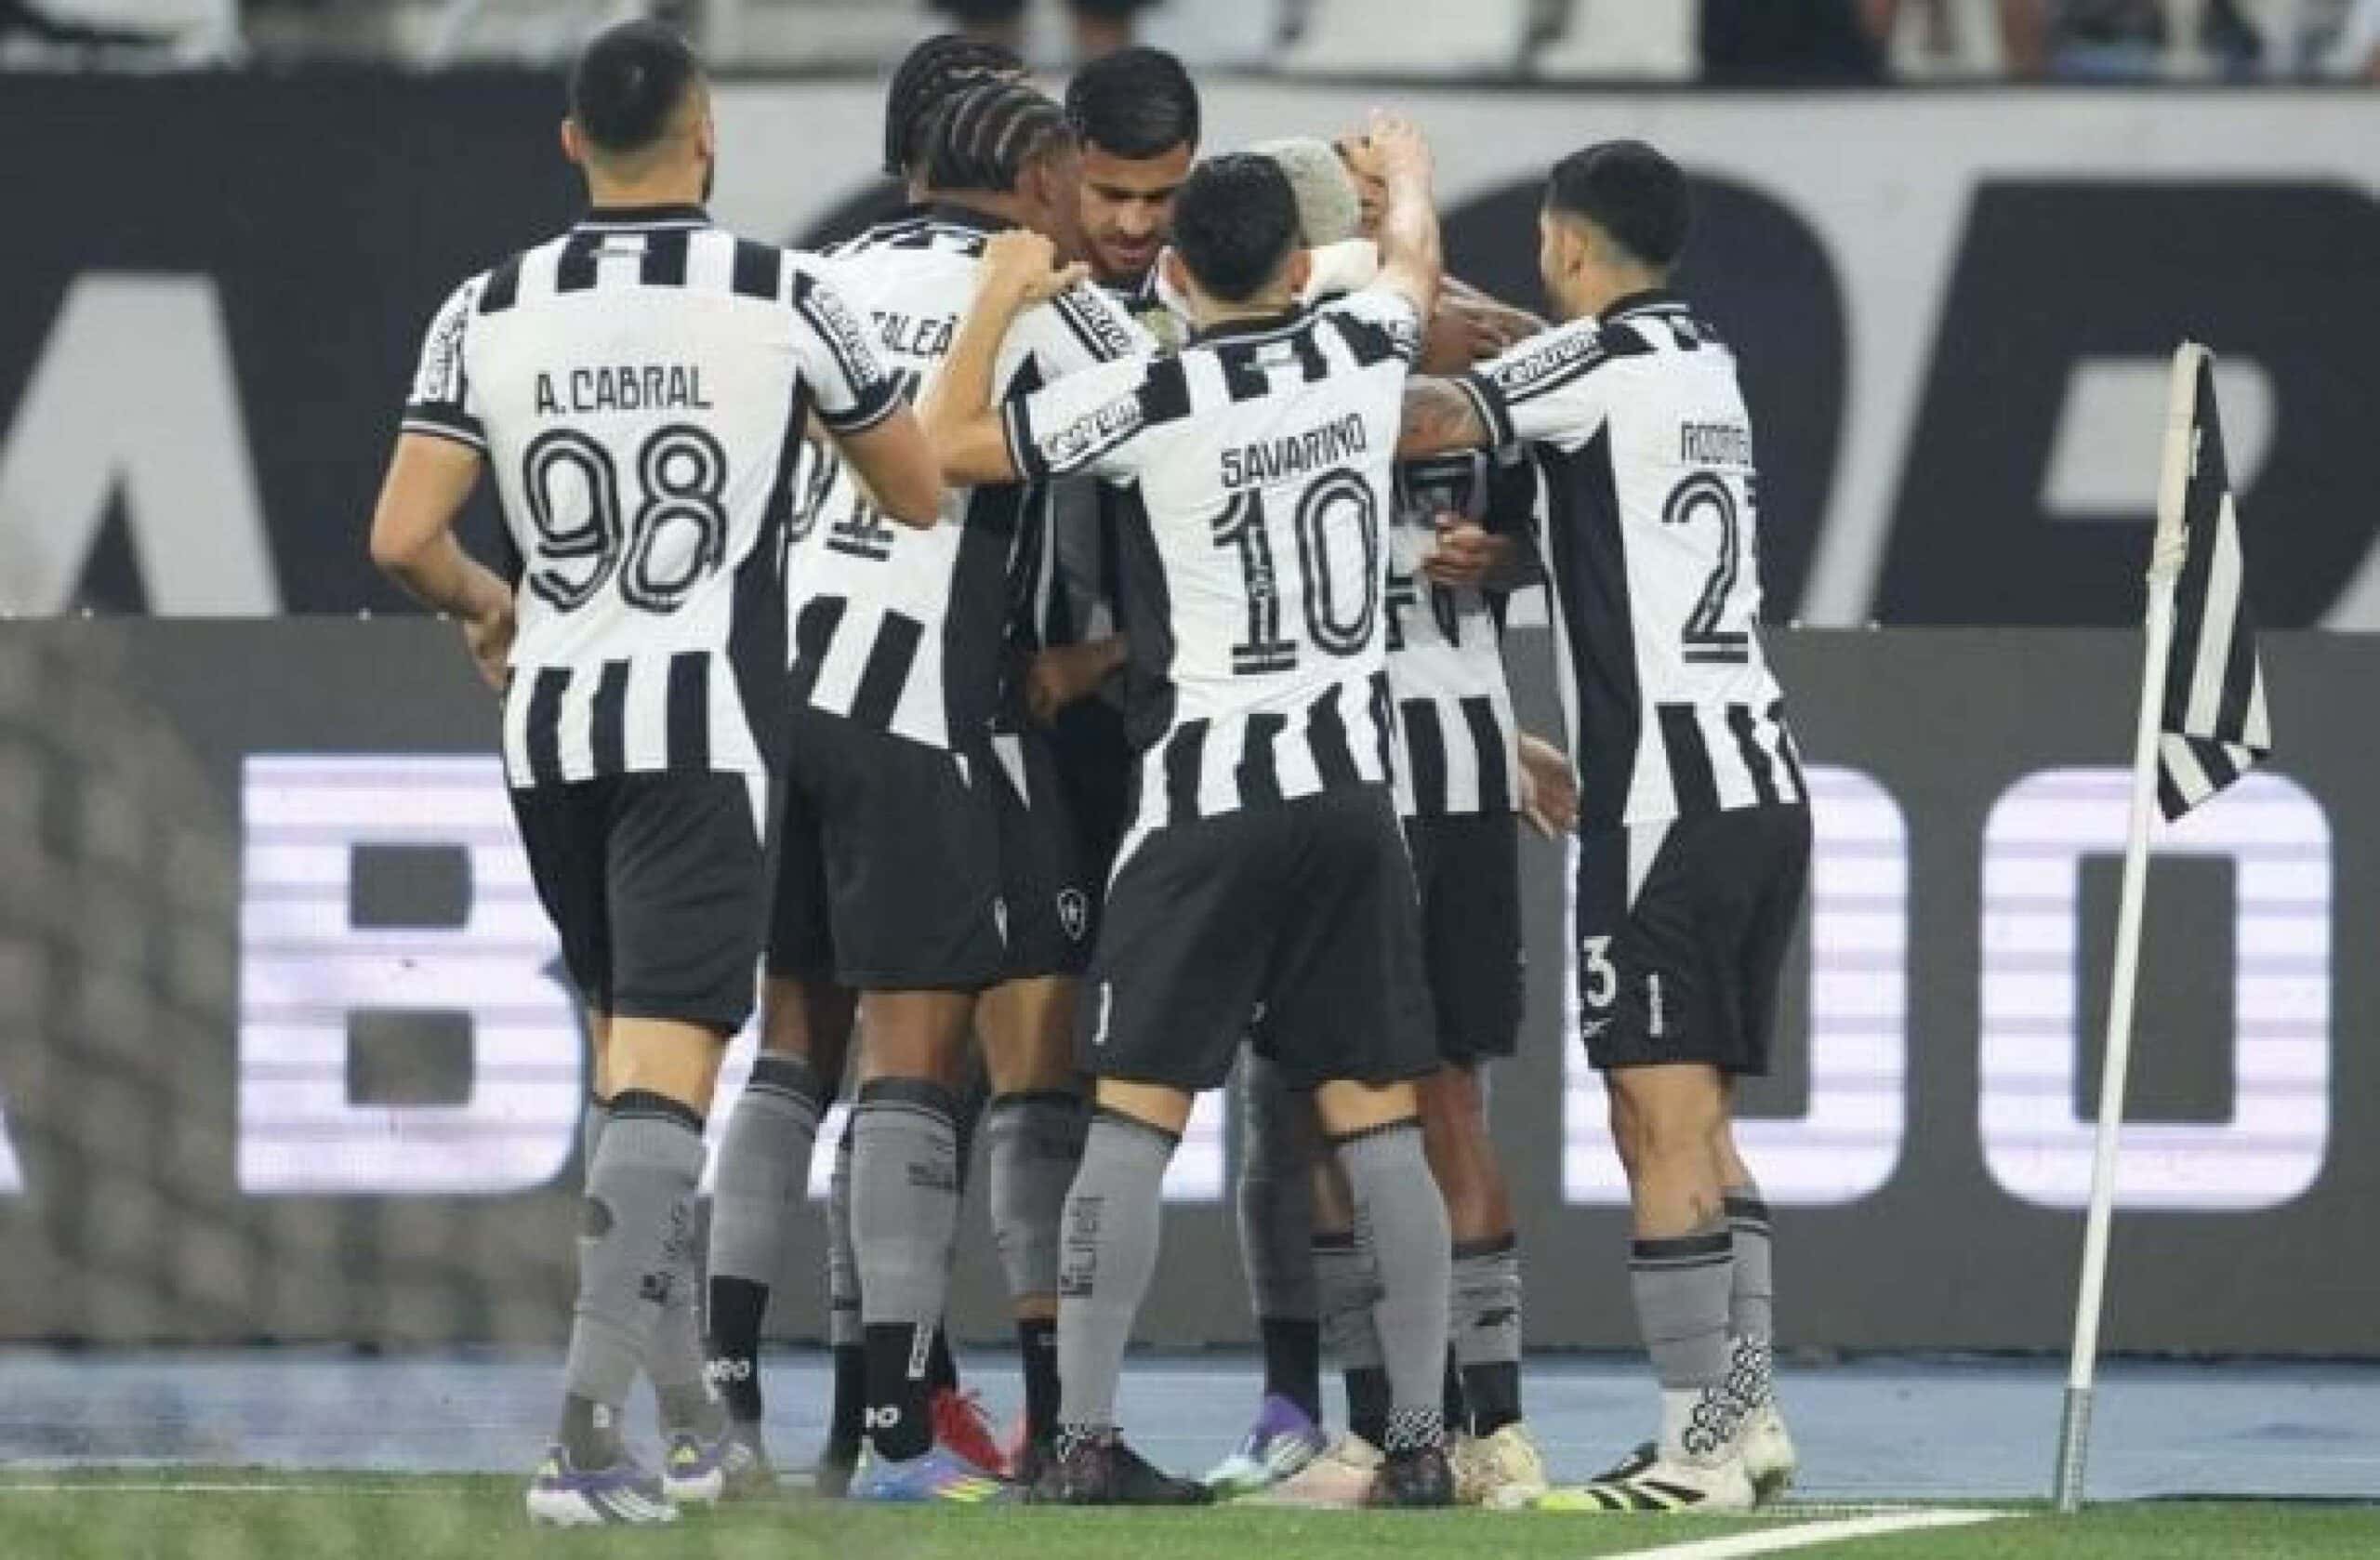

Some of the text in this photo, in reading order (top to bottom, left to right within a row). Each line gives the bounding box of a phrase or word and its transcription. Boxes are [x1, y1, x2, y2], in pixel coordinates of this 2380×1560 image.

[522, 423, 727, 614] 98
[1221, 412, 1368, 488] SAVARINO
[1210, 468, 1379, 676] 10
[1661, 471, 1757, 664] 2
